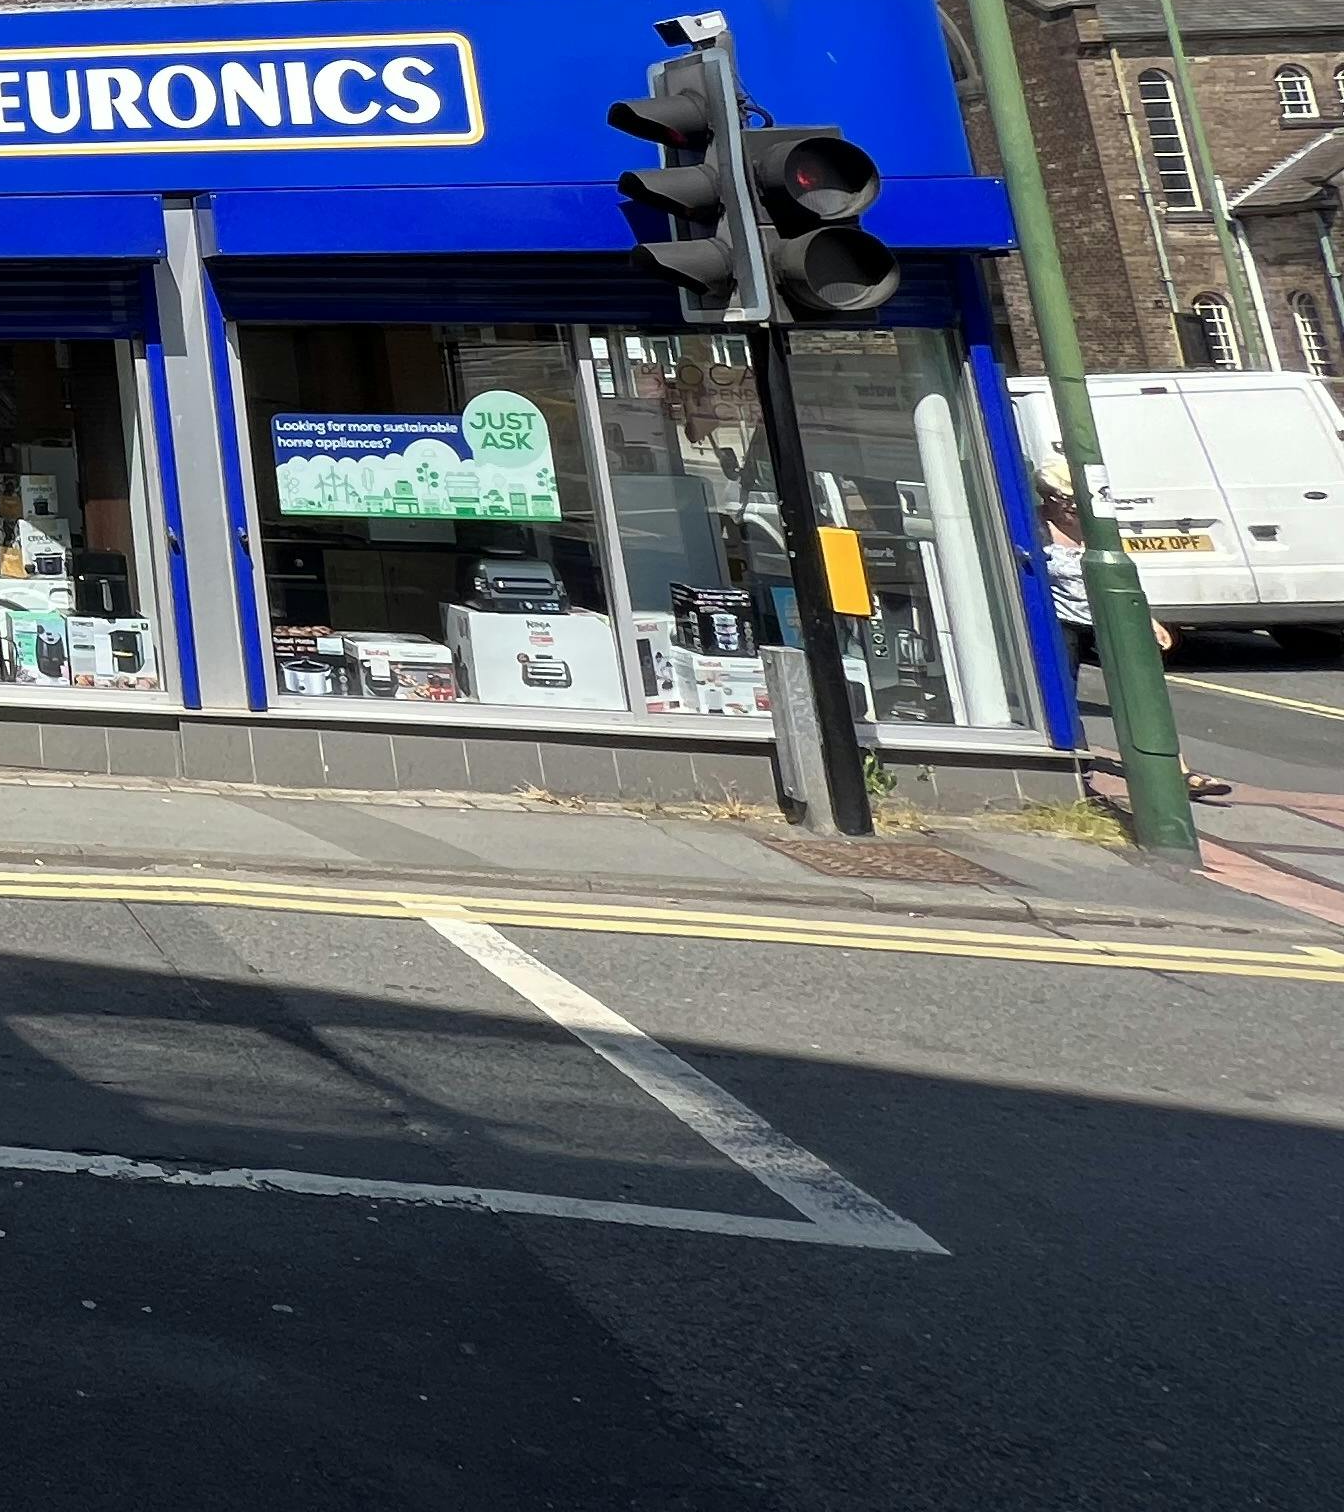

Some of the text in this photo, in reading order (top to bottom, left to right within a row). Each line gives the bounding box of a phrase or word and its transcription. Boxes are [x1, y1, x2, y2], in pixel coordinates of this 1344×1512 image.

[276, 420, 458, 435] Looking for more sustainable
[470, 412, 537, 430] JUST
[277, 437, 392, 451] home appliances?
[481, 432, 534, 450] ASK
[1128, 538, 1167, 551] NX12
